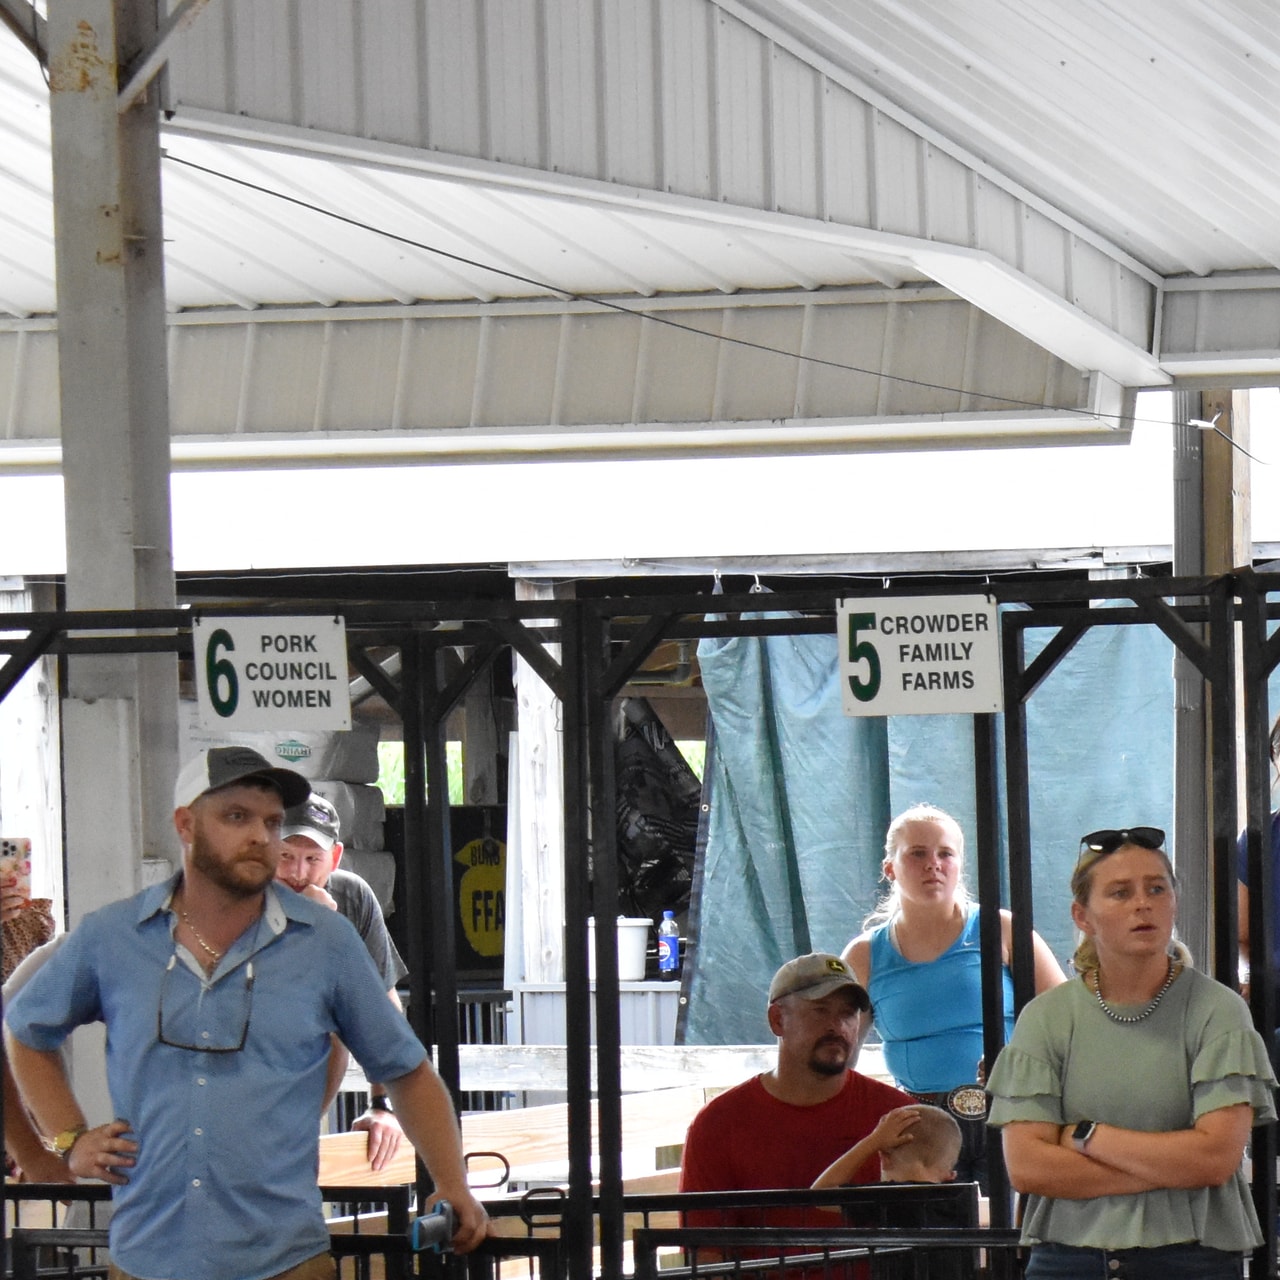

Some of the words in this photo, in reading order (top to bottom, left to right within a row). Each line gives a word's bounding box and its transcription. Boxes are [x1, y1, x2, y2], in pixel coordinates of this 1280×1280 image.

[880, 613, 989, 636] CROWDER
[261, 635, 318, 653] PORK
[898, 642, 974, 663] FAMILY
[848, 612, 881, 702] 5
[206, 628, 239, 718] 6
[245, 662, 337, 681] COUNCIL
[902, 670, 975, 691] FARMS
[252, 689, 332, 708] WOMEN
[471, 890, 505, 933] FFA
